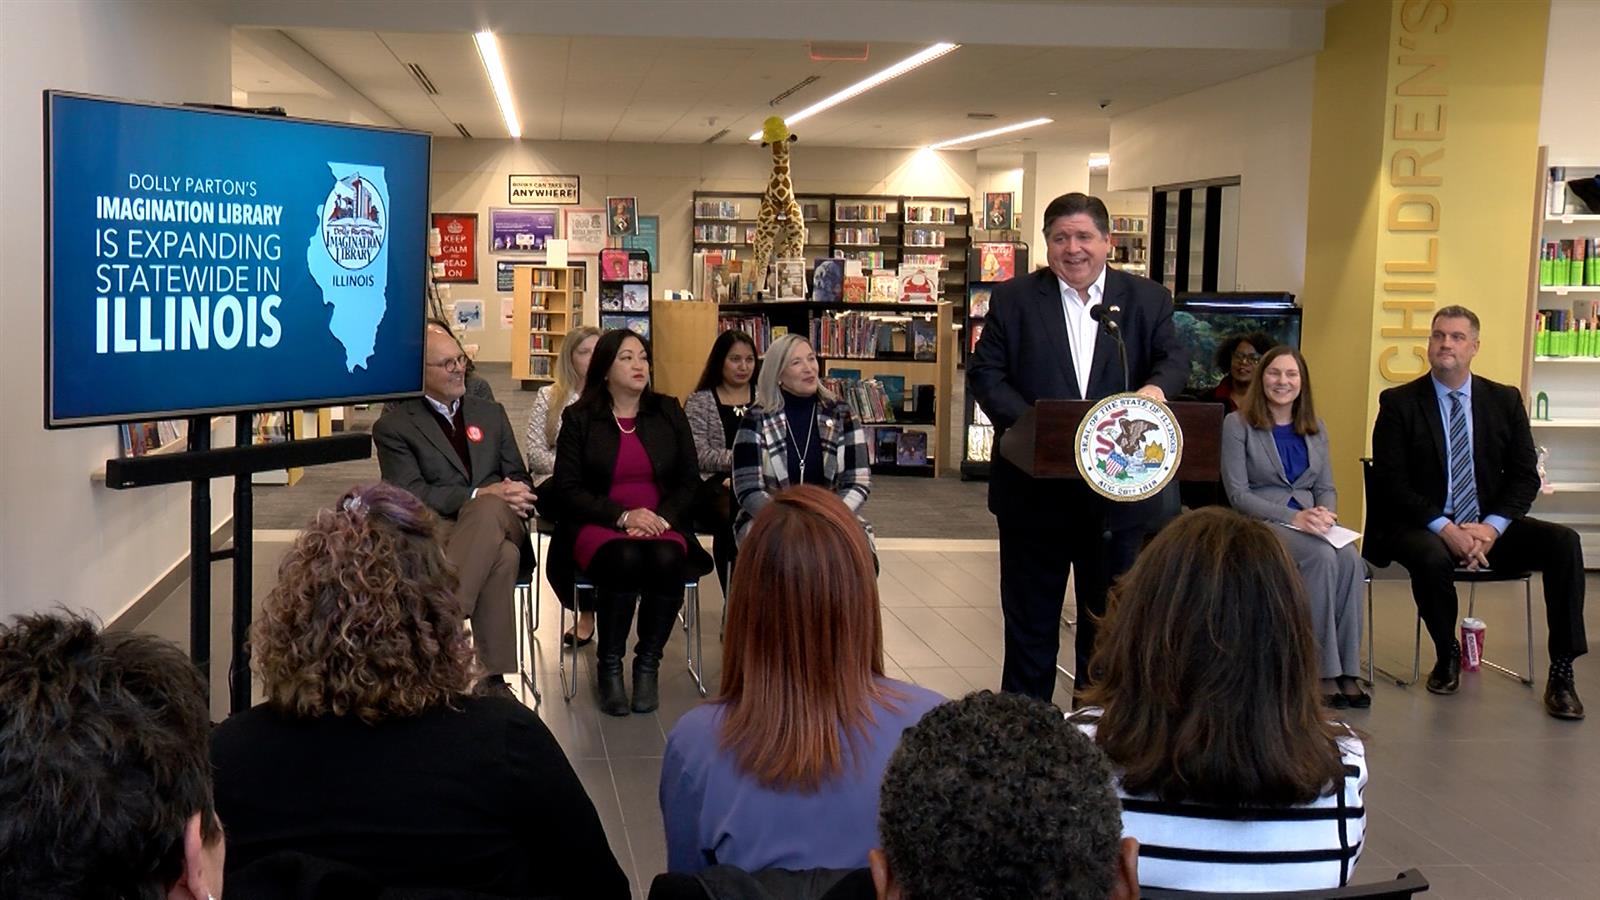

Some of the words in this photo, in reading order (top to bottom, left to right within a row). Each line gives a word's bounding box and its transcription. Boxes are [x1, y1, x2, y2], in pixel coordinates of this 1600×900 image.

[129, 173, 181, 192] DOLLY
[185, 177, 258, 197] PARTON'S
[512, 189, 577, 198] ANYWHERE!
[1378, 0, 1449, 383] CHILDREN'S
[96, 196, 215, 224] IMAGINATION
[218, 202, 283, 226] LIBRARY
[96, 228, 119, 259] IS
[128, 229, 281, 261] EXPANDING
[326, 231, 382, 249] IMAGINATION
[443, 235, 467, 243] KEEP
[336, 247, 371, 263] LIBRARY
[442, 245, 468, 254] CALM
[443, 259, 468, 267] READ
[96, 264, 249, 294] STATEWIDE
[257, 266, 280, 293] IN
[332, 274, 375, 288] ILLINOIS
[447, 269, 463, 277] ON
[96, 294, 282, 354] ILLINOIS
[1089, 414, 1099, 427] OF
[1099, 400, 1119, 415] THE
[1119, 399, 1148, 408] STATE
[1149, 404, 1161, 414] OF
[1160, 414, 1177, 454] ILLINOIS
